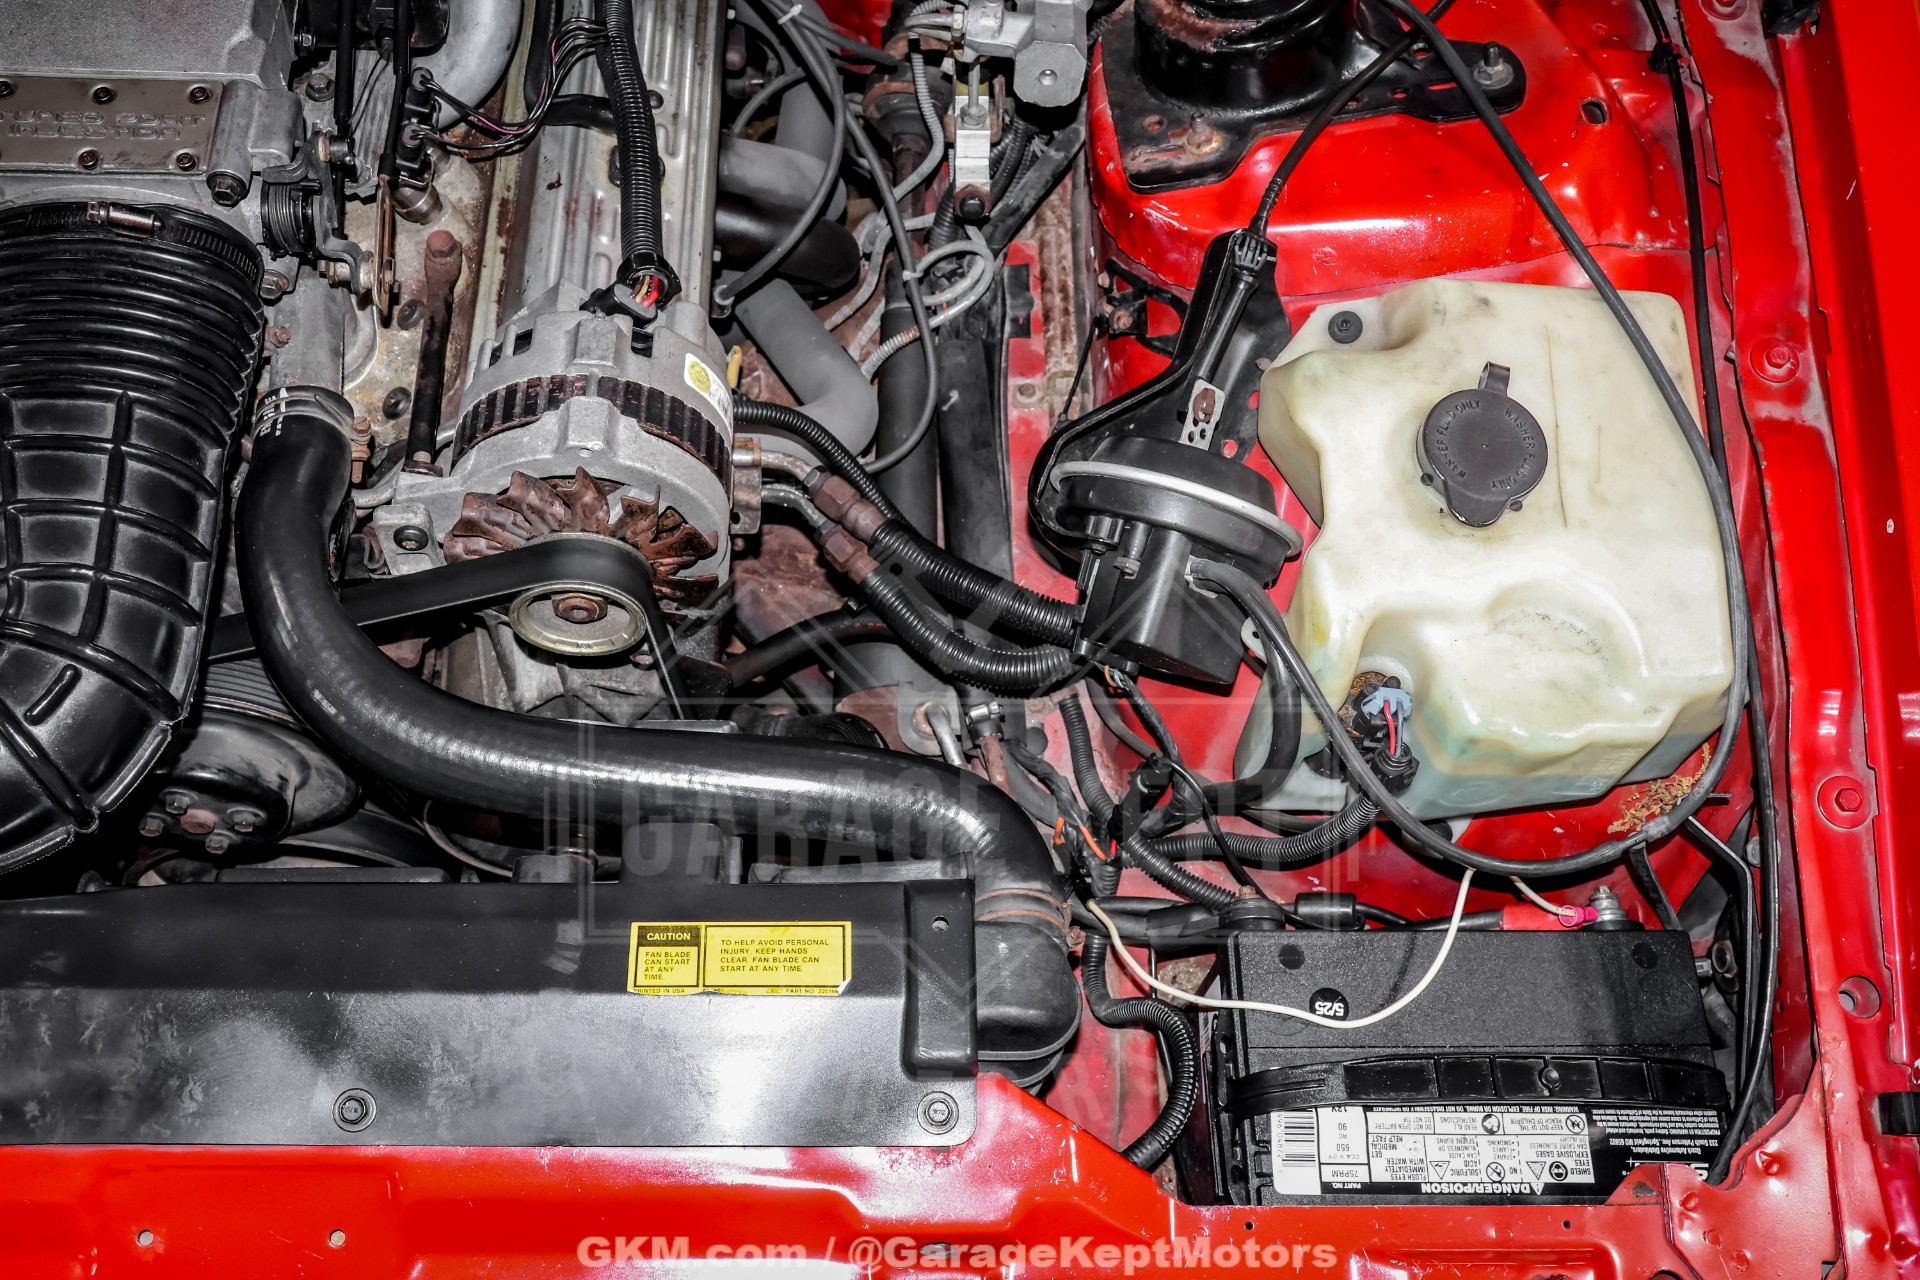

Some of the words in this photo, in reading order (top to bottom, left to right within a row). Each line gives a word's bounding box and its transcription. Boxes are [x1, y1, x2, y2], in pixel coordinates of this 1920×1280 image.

[116, 111, 206, 127] PORT
[8, 124, 181, 139] INJECTION
[1455, 399, 1480, 412] ONLY
[1503, 409, 1536, 449] WASHER
[646, 932, 691, 941] CAUTION
[1314, 1001, 1345, 1017] 5/25
[1337, 1122, 1347, 1131] 90
[1389, 1135, 1403, 1143] HELP
[1336, 1143, 1350, 1151] 650
[1370, 1142, 1397, 1150] MEDICAL
[1529, 1142, 1558, 1150] BLINDNESS
[1558, 1142, 1574, 1150] CAUSE
[1575, 1142, 1588, 1150] CAN
[1371, 1150, 1383, 1158] GET
[1535, 1151, 1555, 1159] GASES
[1556, 1151, 1589, 1159] EXPLOSIVE
[1573, 1159, 1590, 1167] EYES.
[1331, 1169, 1360, 1177] 75PRM
[1385, 1165, 1425, 1173] IMMEDIATELY
[1450, 1168, 1479, 1177] SULFURIC
[1509, 1167, 1518, 1175] NO
[1570, 1167, 1591, 1176] SHIELD
[1390, 1173, 1408, 1181] EYES
[1409, 1173, 1427, 1181] FLUSH
[1421, 1182, 1531, 1194] DANGER/POISON
